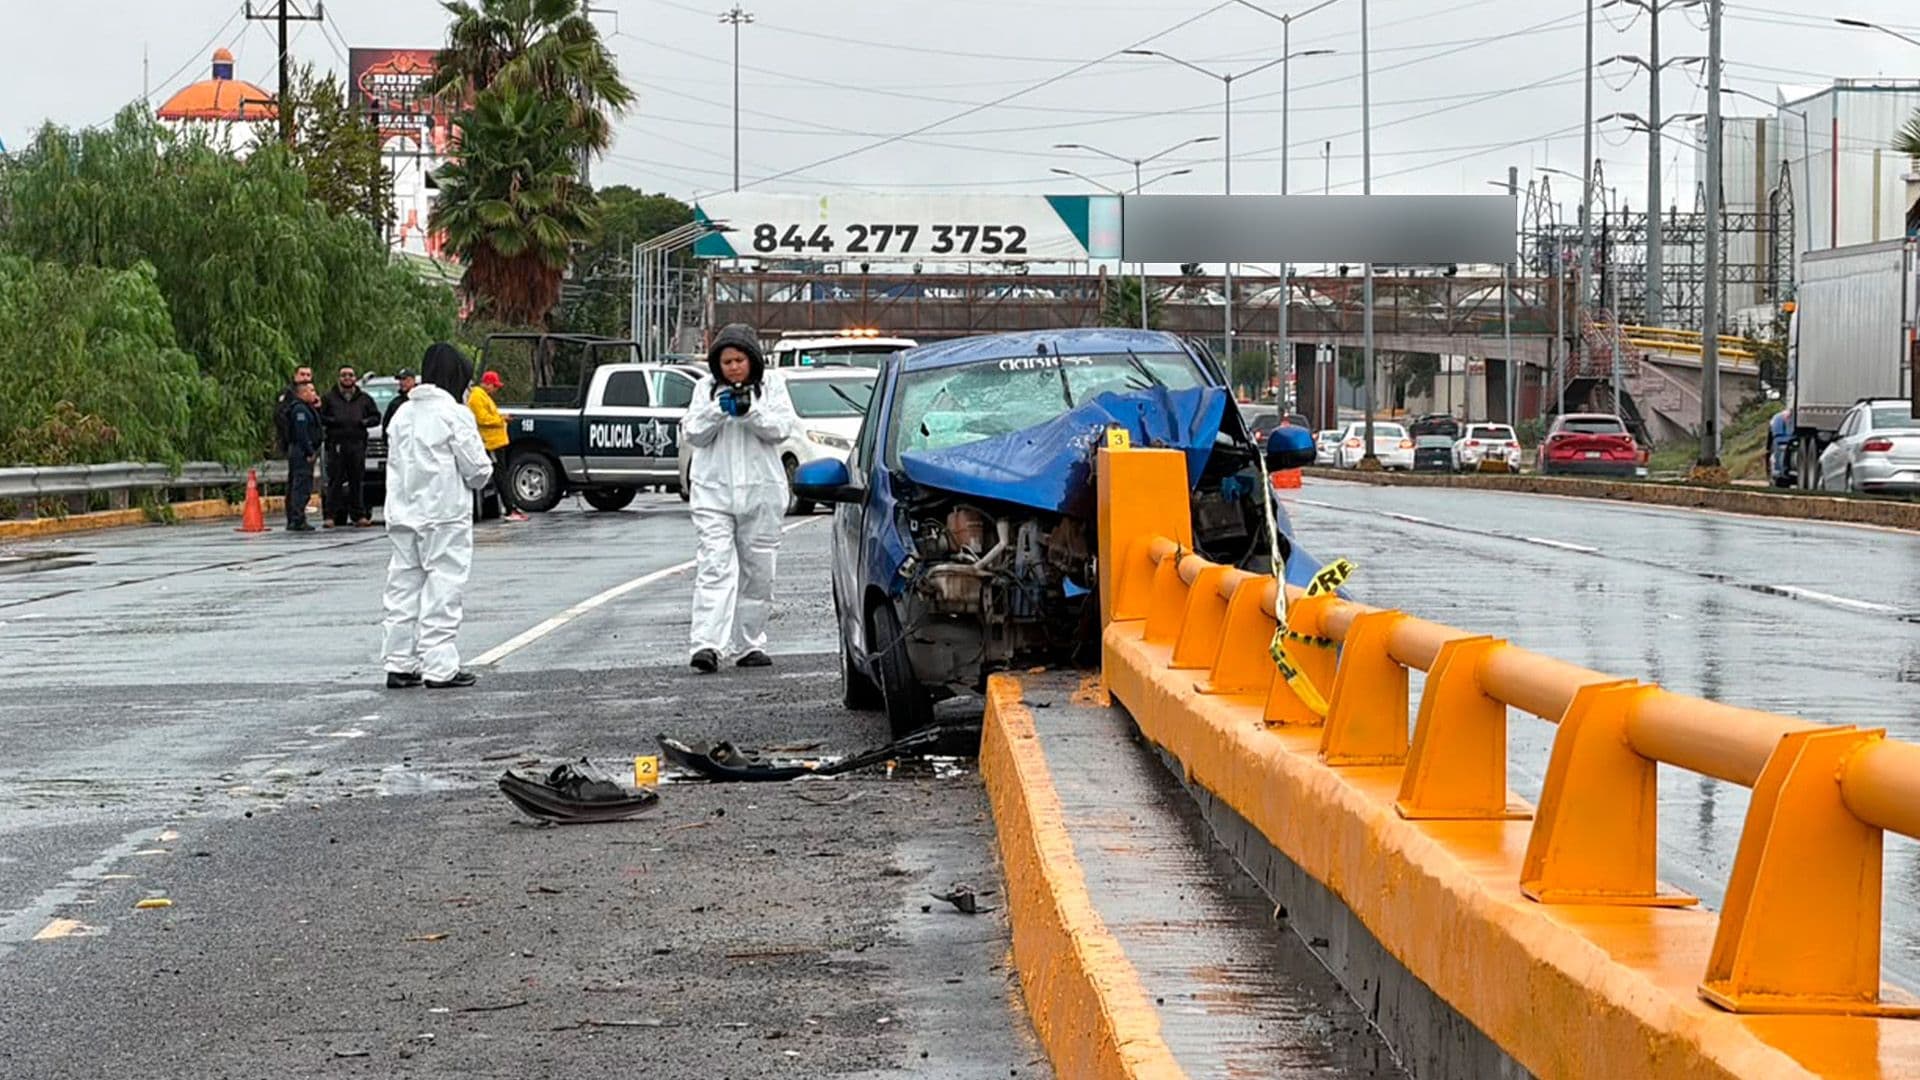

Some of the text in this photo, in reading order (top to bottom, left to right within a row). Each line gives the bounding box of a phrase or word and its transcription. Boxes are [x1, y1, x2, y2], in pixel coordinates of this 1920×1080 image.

[753, 223, 1027, 254] 844 277 3752
[590, 424, 633, 448] POLICIA
[1113, 434, 1124, 445] 3
[642, 761, 652, 773] 2
